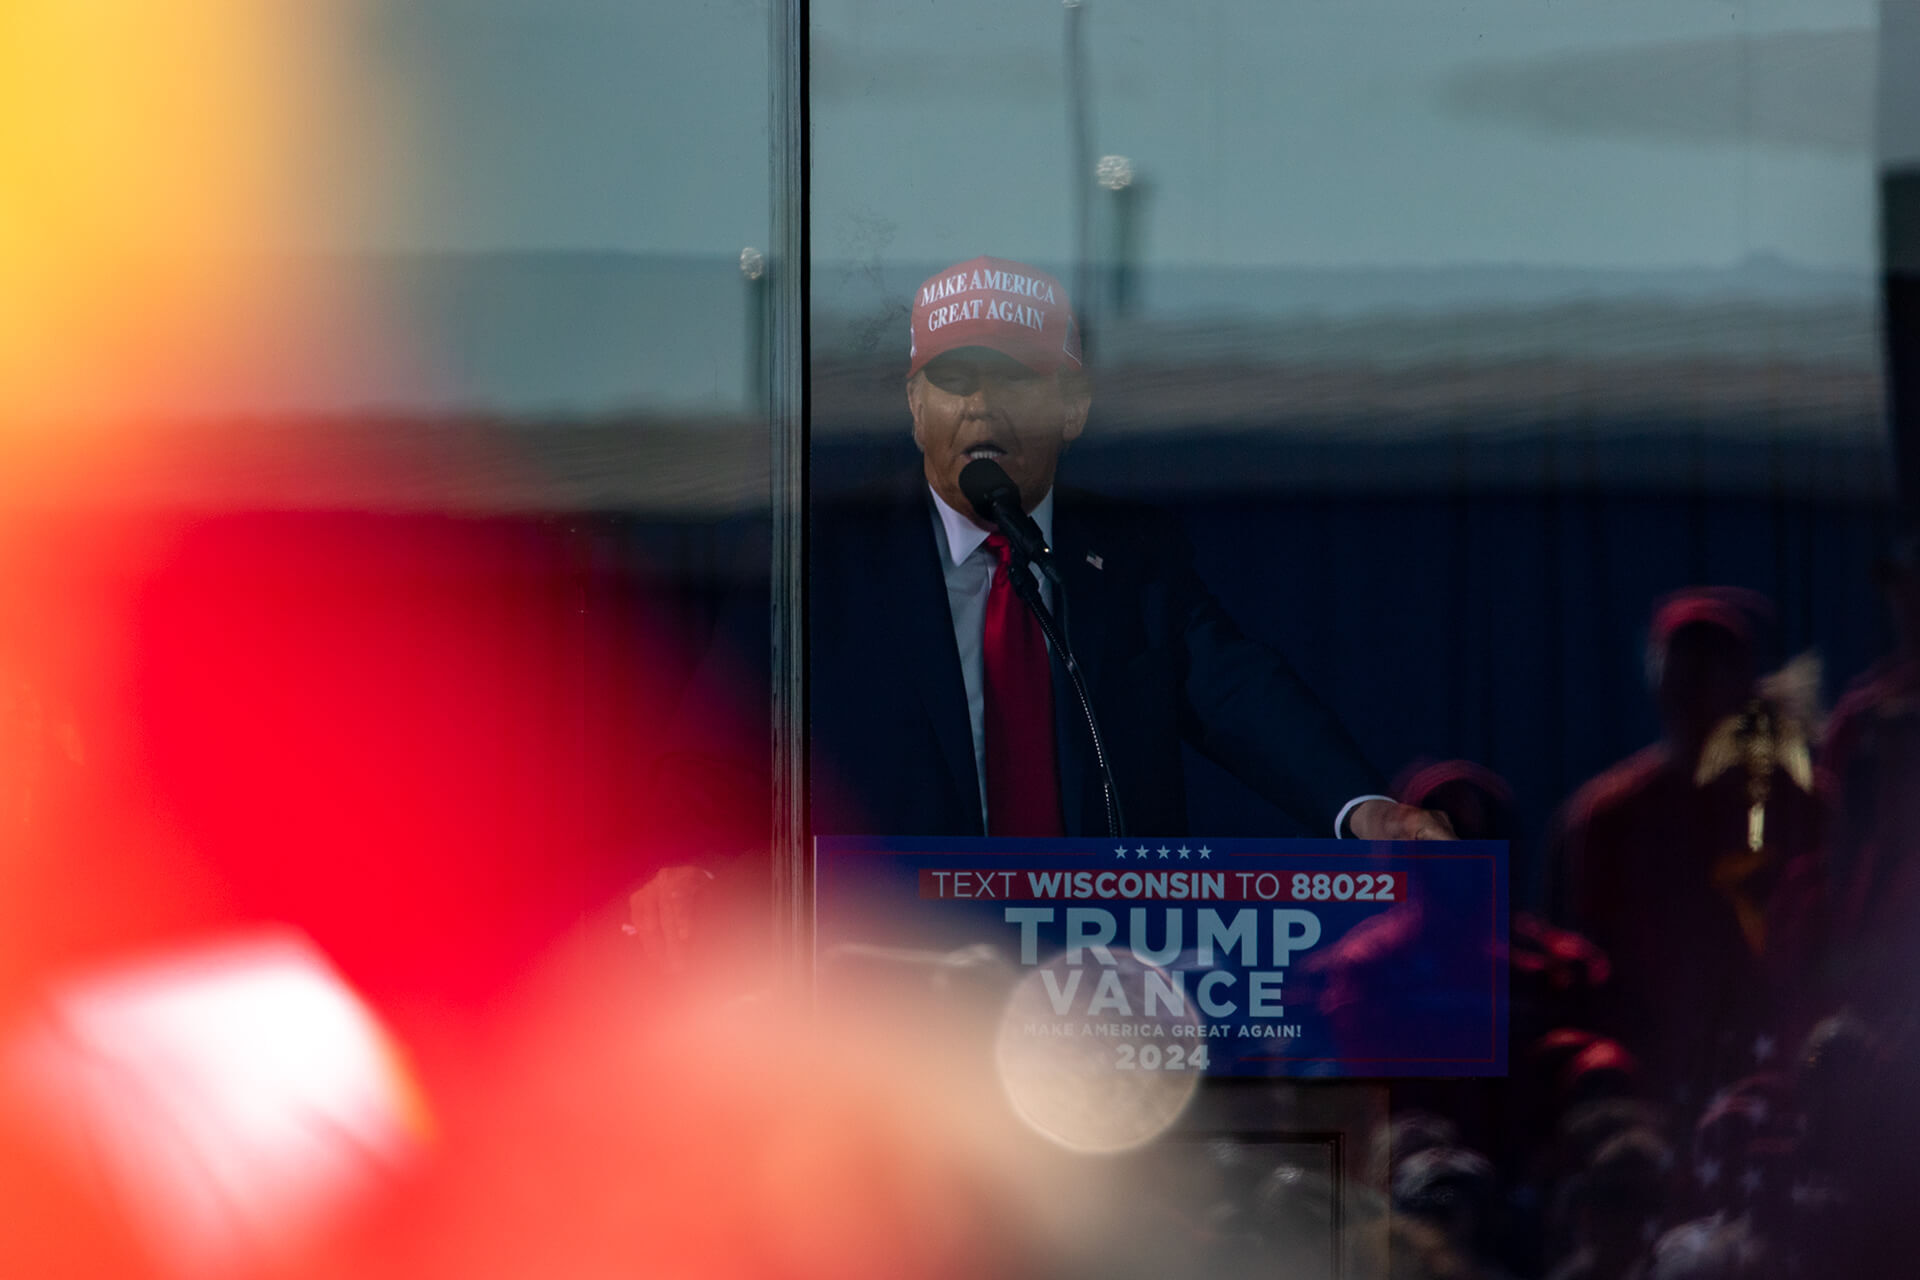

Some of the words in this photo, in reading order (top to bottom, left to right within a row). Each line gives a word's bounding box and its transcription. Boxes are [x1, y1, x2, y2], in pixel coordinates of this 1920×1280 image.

[921, 272, 967, 307] MAKE
[969, 269, 1056, 305] AMERICA
[928, 299, 983, 332] GREAT
[985, 299, 1045, 332] AGAIN
[932, 871, 1017, 897] TEXT
[1028, 872, 1225, 898] WISCONSIN
[1236, 873, 1280, 899] TO
[1291, 873, 1395, 900] 88022
[1005, 908, 1321, 967] TRUMP
[1040, 970, 1284, 1018] VANCE
[1024, 1024, 1074, 1037] MAKE
[1081, 1024, 1164, 1037] AMERICA
[1171, 1024, 1231, 1038] GREAT
[1238, 1025, 1302, 1038] AGAIN!
[1115, 1044, 1210, 1071] 2024
